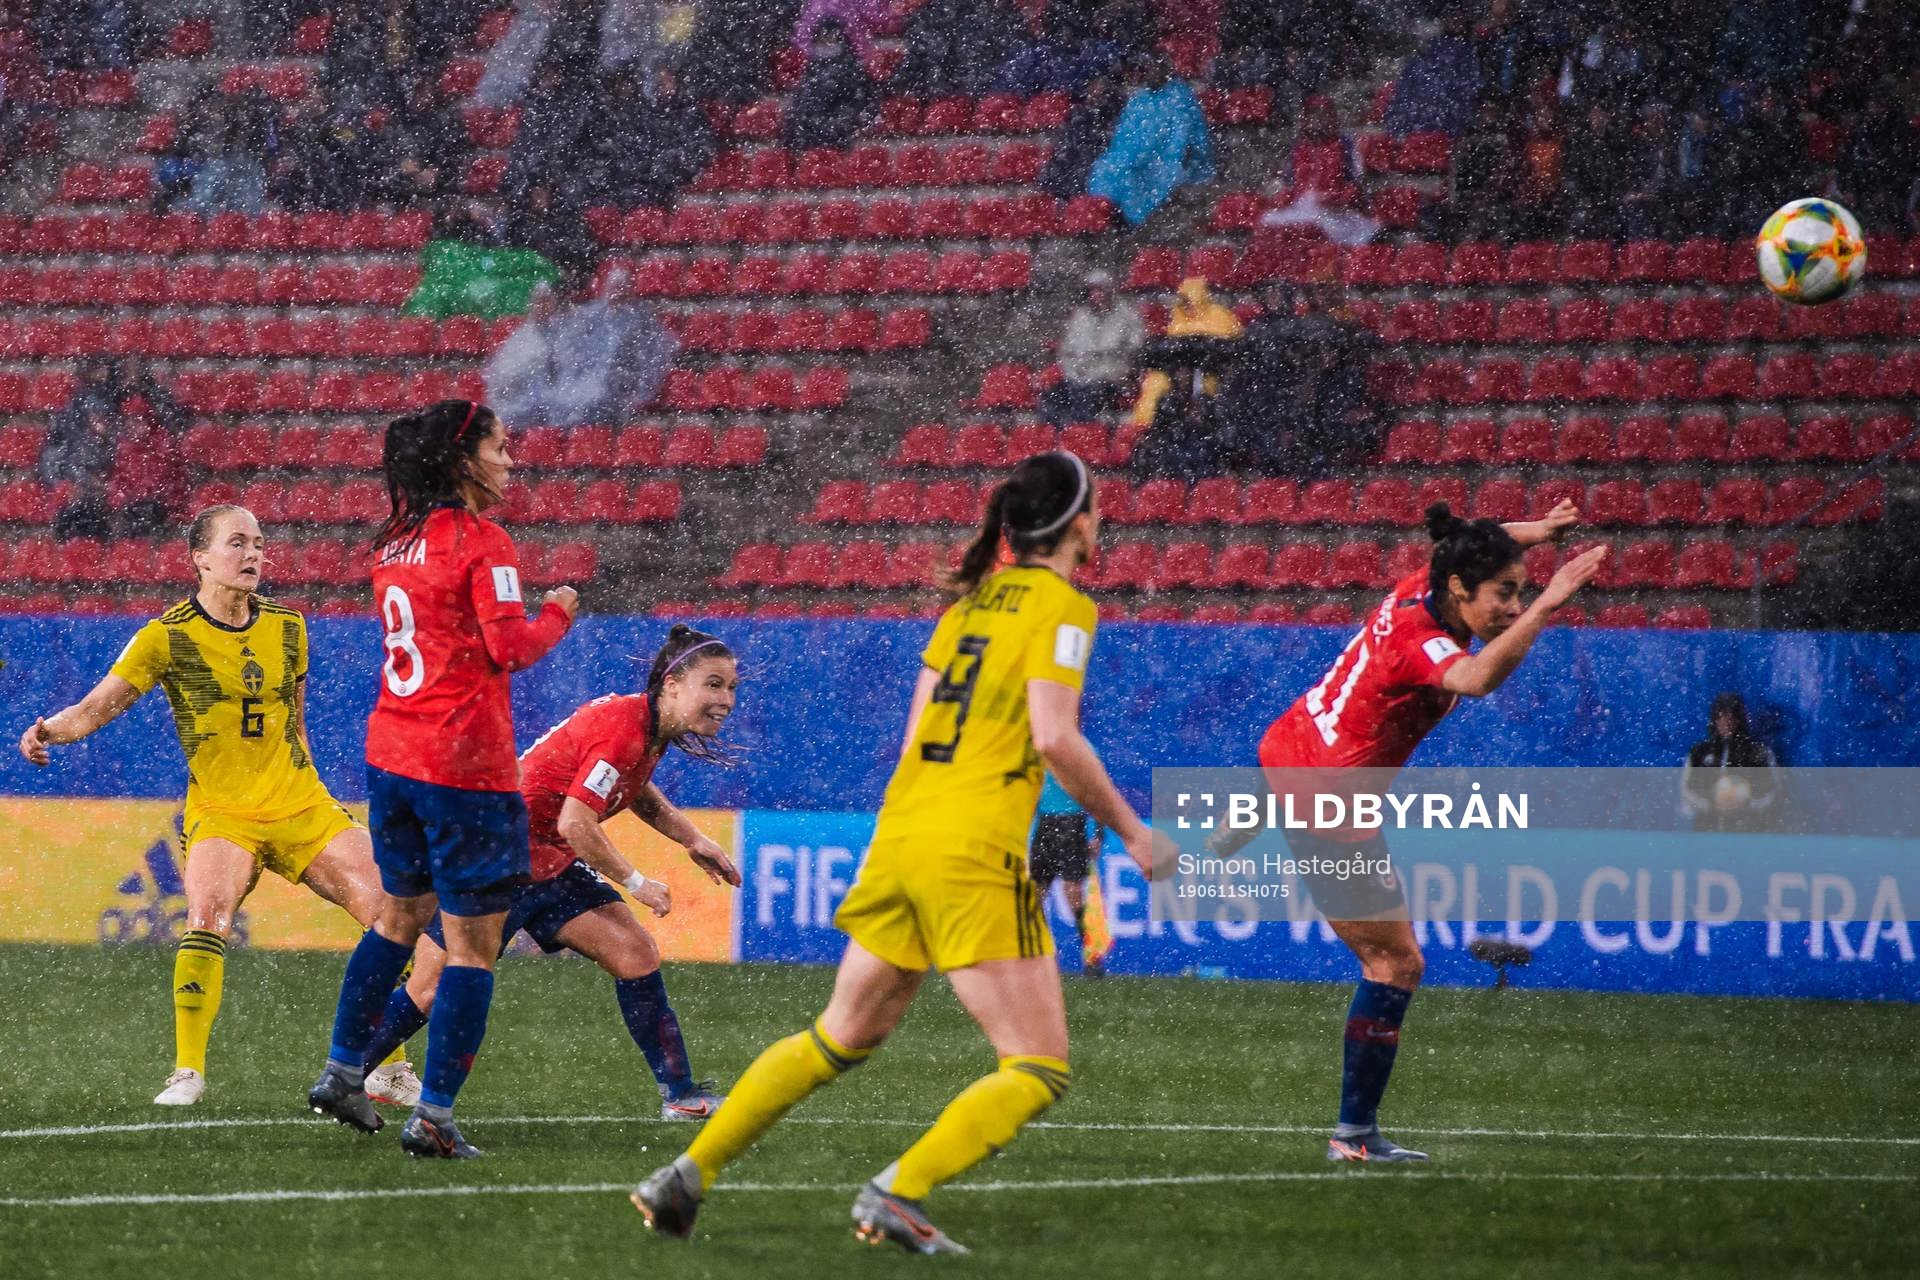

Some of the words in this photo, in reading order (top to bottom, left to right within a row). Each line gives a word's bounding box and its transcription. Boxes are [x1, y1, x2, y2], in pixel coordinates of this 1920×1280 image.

[383, 584, 425, 698] 8
[921, 633, 991, 764] 9
[241, 697, 265, 738] 6
[756, 844, 854, 929] FIF
[1279, 860, 1558, 949] WRLD
[1579, 865, 1742, 955] CUP
[1763, 871, 1917, 962] FRA
